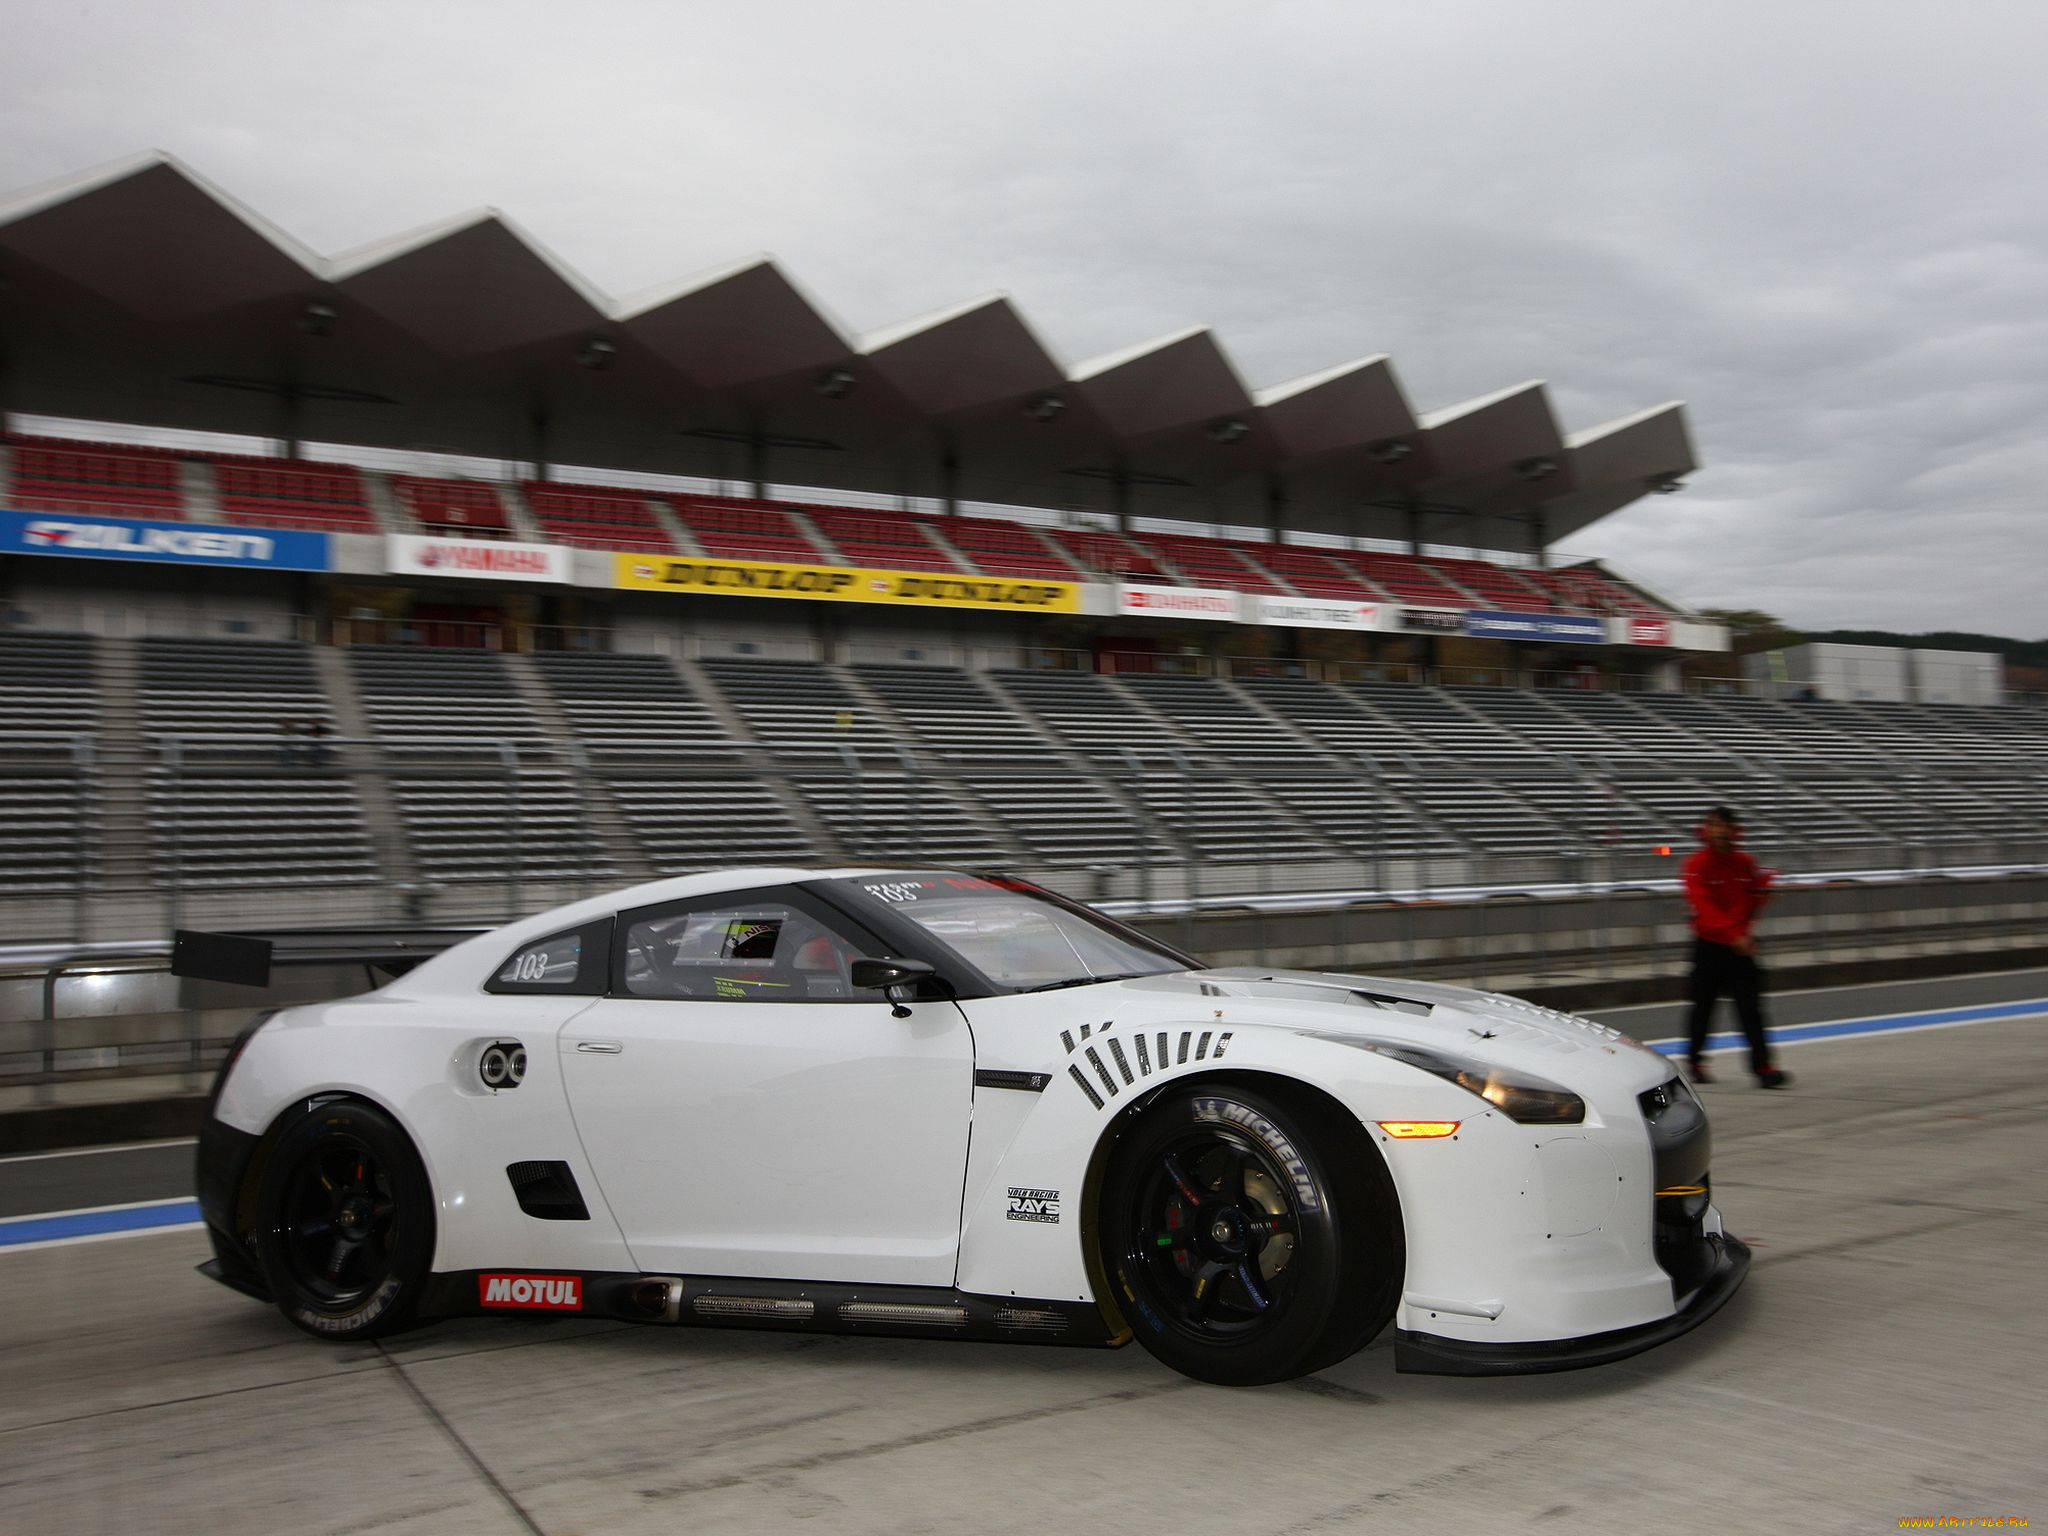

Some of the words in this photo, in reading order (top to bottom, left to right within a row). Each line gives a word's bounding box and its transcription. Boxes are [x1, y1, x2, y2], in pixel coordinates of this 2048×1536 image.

[21, 520, 275, 561] FALKEN
[660, 563, 859, 593] DUNLOP
[894, 577, 1068, 606] DUNLOP
[871, 889, 917, 904] 103
[513, 952, 549, 982] 103
[1222, 1102, 1318, 1208] MICHELIN
[1006, 1212, 1060, 1224] ENGINEERING
[1008, 1197, 1060, 1214] RAYS
[485, 1278, 578, 1305] MOTUL
